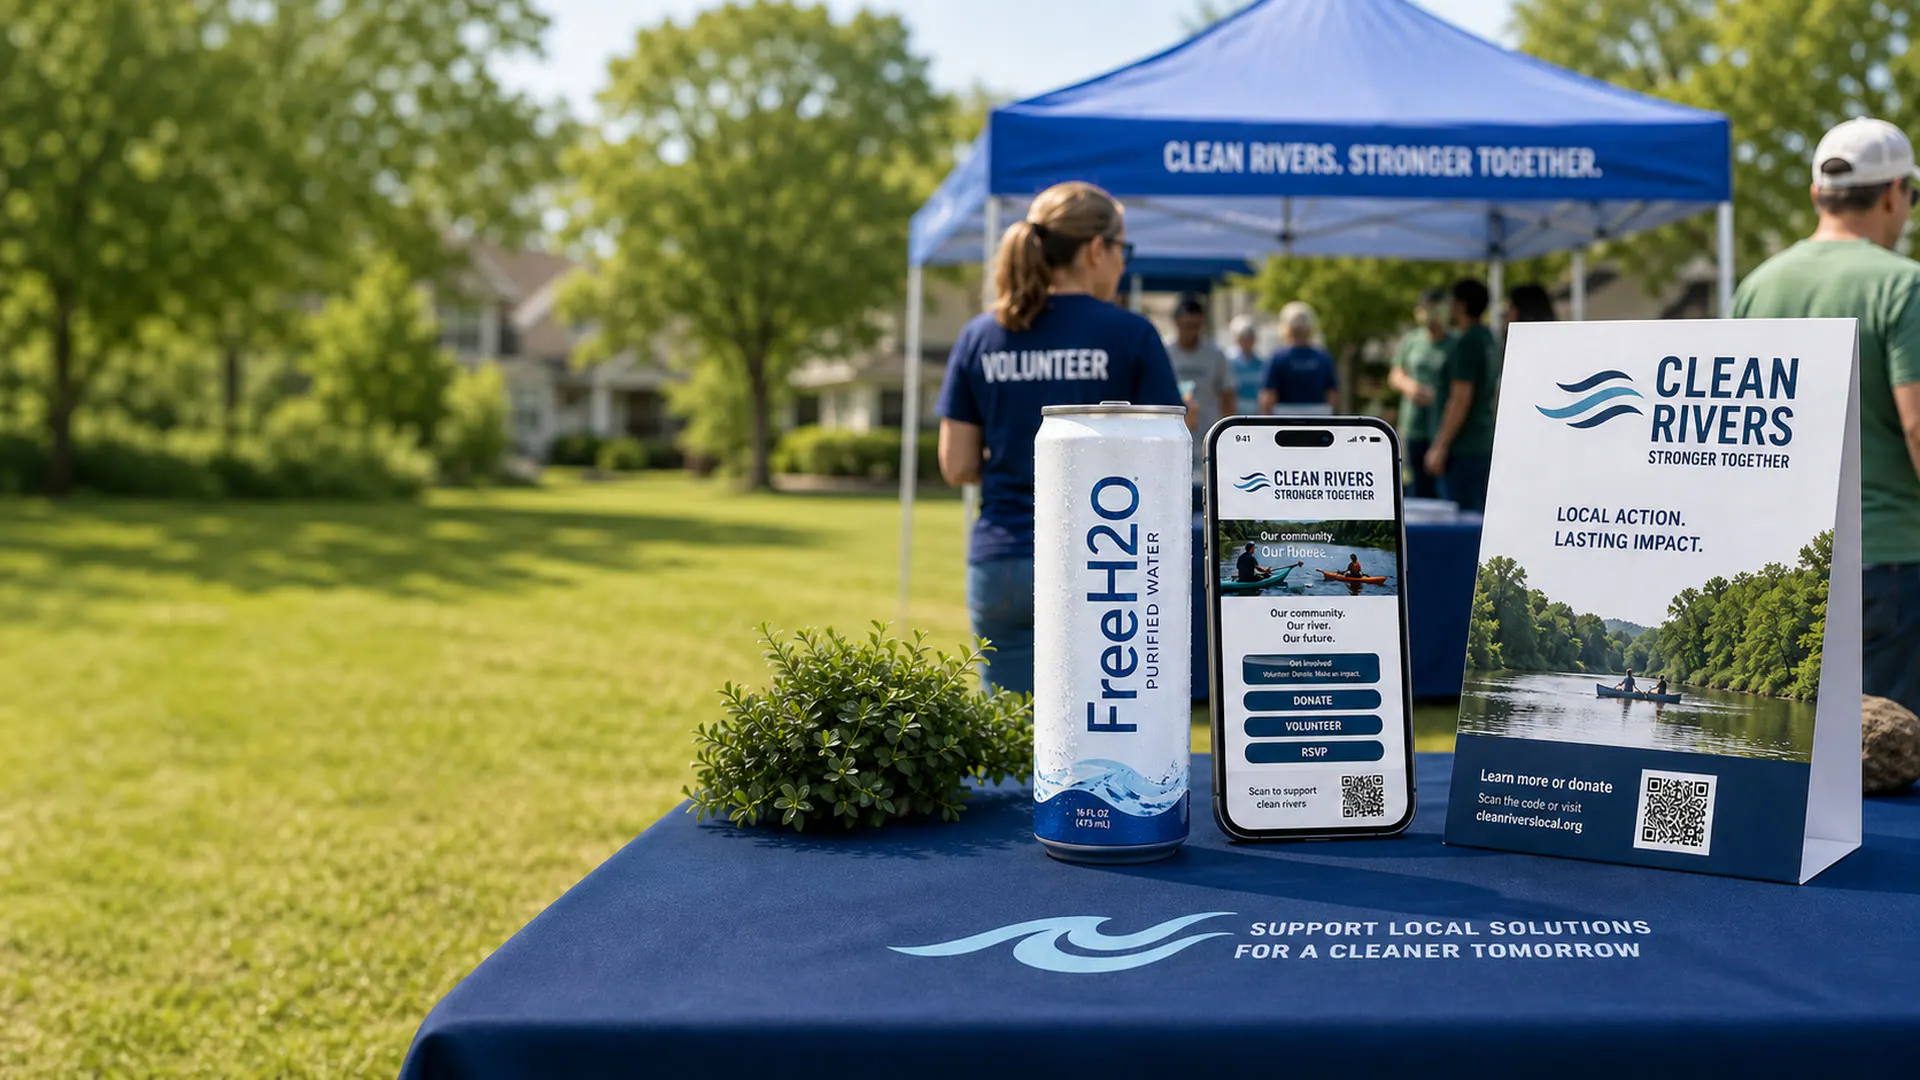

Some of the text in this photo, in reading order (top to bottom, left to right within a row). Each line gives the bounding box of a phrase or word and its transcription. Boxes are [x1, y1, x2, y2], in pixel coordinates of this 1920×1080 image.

[1164, 141, 1602, 178] CLEAN RIVERS. STRONGER TOGETHER.
[981, 349, 1108, 382] VOLUNTEER
[1655, 355, 1799, 400] CLEAN
[1650, 404, 1794, 447] RIVERS
[1648, 450, 1790, 468] STRONGER TOGETHER
[1274, 470, 1374, 487] CLEAN RIVERS
[1274, 489, 1375, 500] STRONGER TOGETHER
[1557, 506, 1686, 526] LOCAL ACTION.
[1260, 531, 1336, 543] Our community.
[1554, 531, 1703, 552] LASTING IMPACT.
[1261, 546, 1285, 558] Our
[1086, 476, 1139, 733] FreeH2O
[1146, 532, 1160, 690] PURIFIED WATER
[1270, 608, 1346, 619] Our community.
[1286, 621, 1331, 631] Our river.
[1283, 633, 1336, 643] Our future.
[1293, 695, 1333, 705] DONATE
[1285, 721, 1342, 731] VOLUNTEER
[1301, 747, 1328, 757] RSVP
[1480, 768, 1613, 794] Learn more or donate
[1248, 786, 1317, 797] Scan to support
[1256, 799, 1307, 809] clean rivers
[1478, 792, 1582, 813] Scan the code or visit
[1076, 808, 1085, 817] 16
[1086, 808, 1096, 817] FL
[1476, 810, 1583, 834] cleanriverslocal.org
[1250, 920, 1652, 936] SUPPORT LOCAL SOLUTIONS
[1234, 943, 1642, 959] FOR A CLEANER TOMORROW
